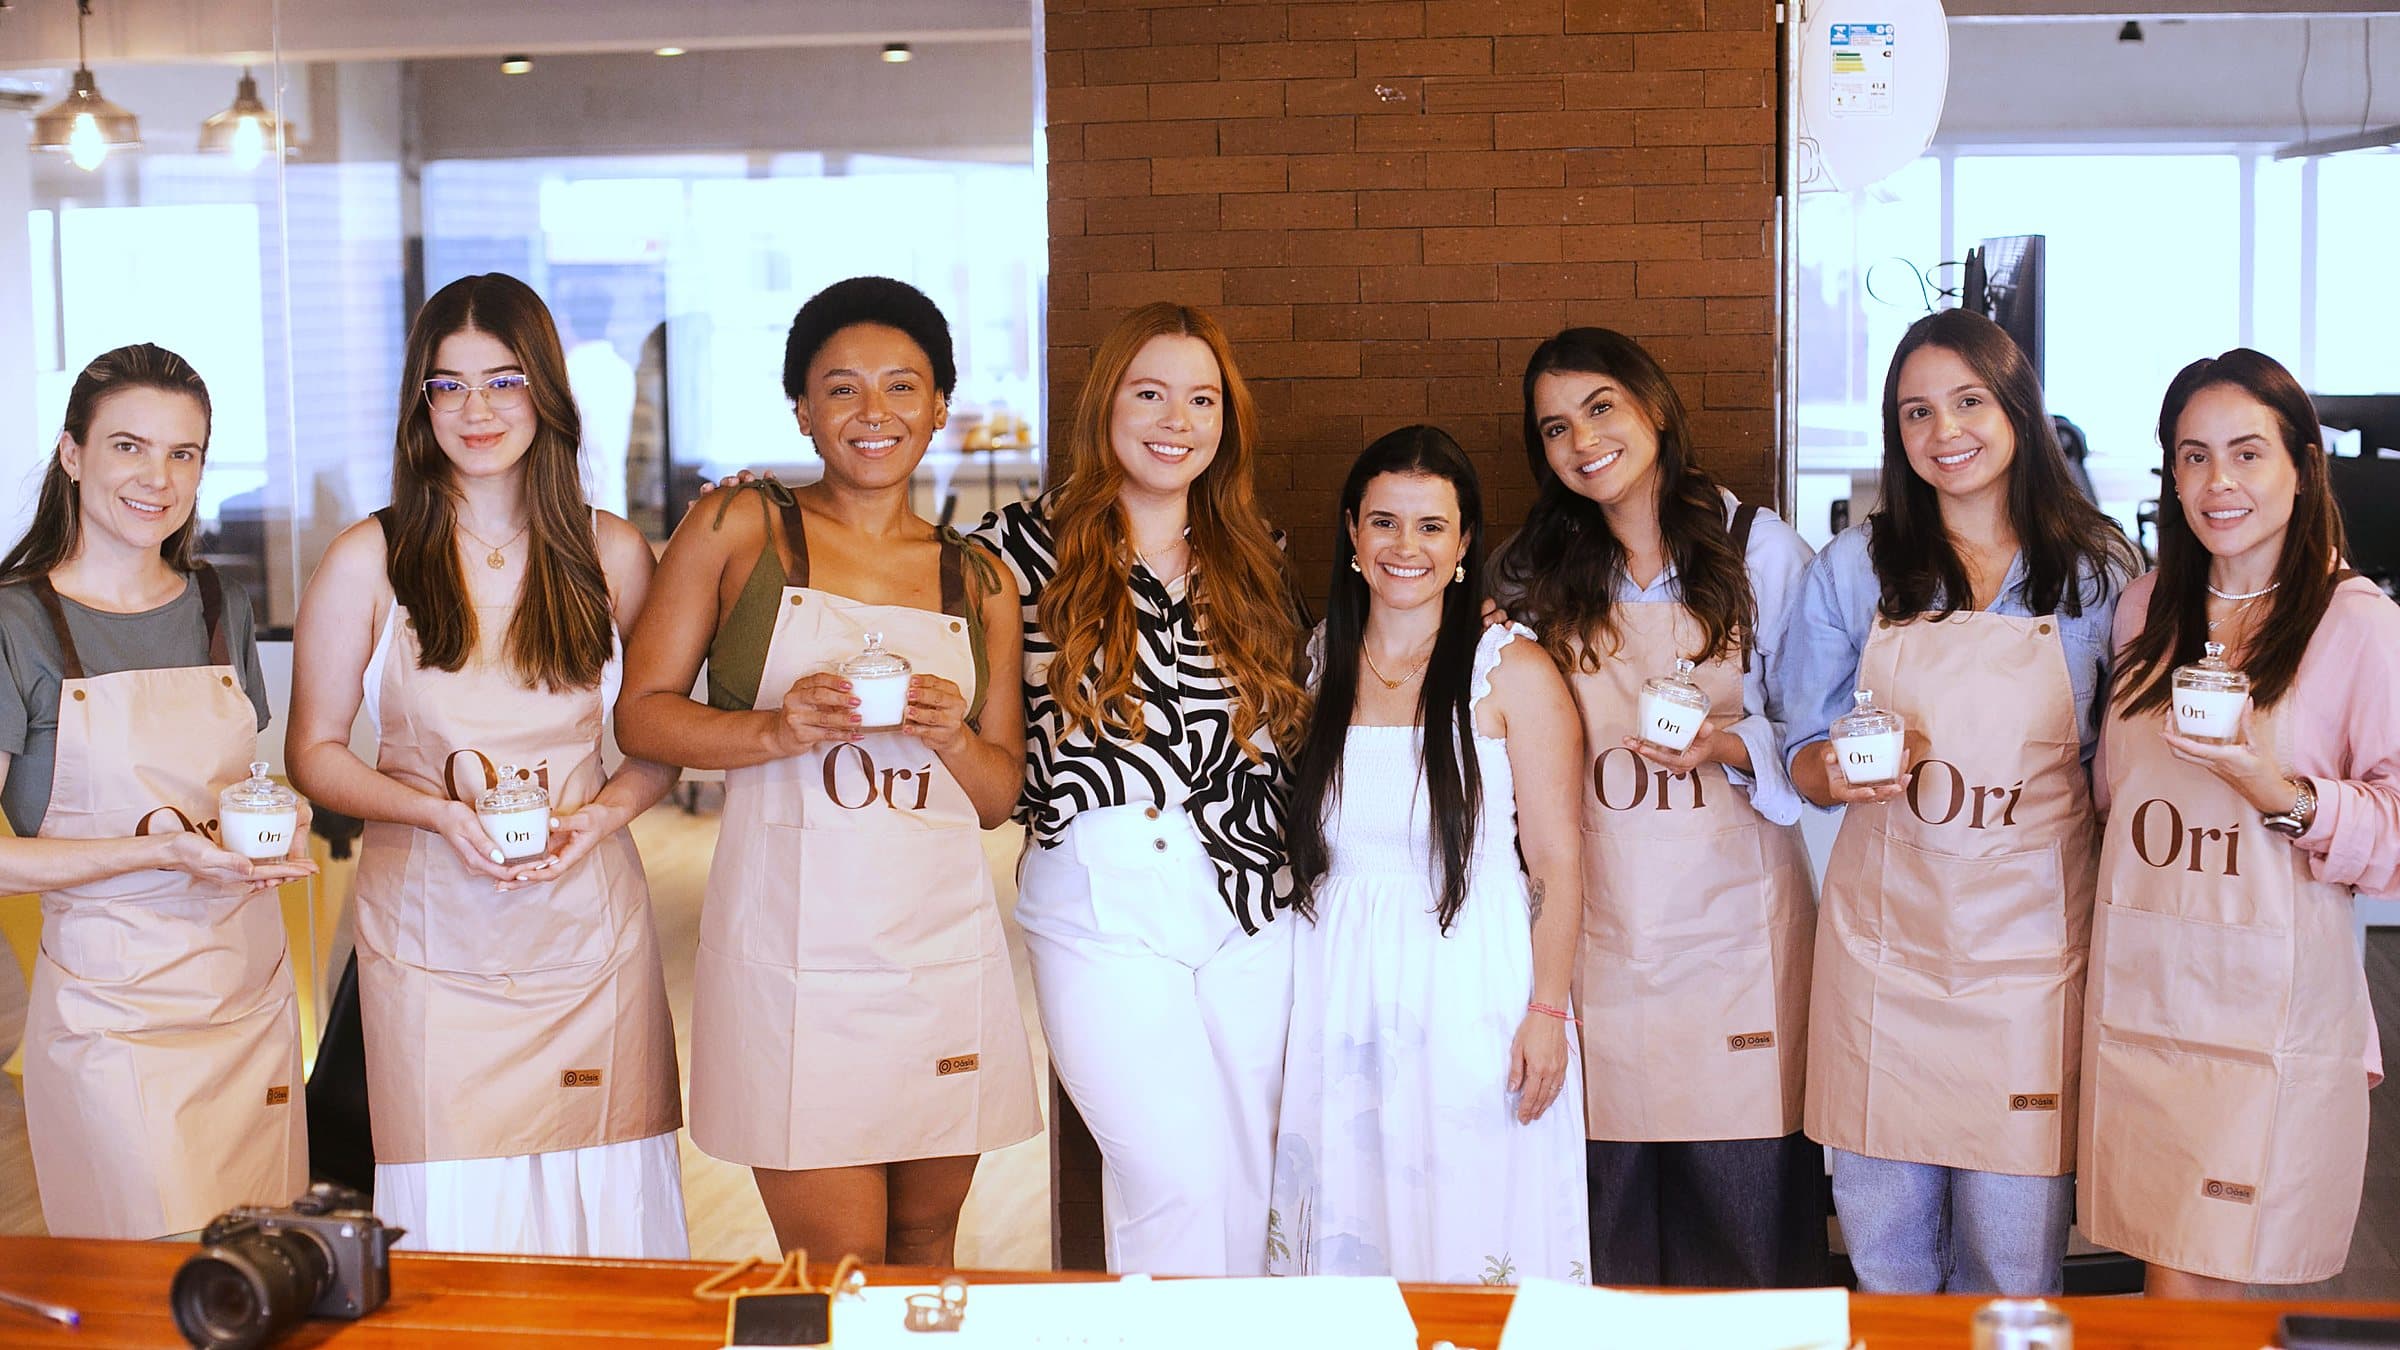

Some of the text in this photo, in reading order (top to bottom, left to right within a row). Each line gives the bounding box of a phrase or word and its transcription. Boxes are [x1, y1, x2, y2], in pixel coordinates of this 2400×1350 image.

[823, 743, 931, 809] Orí
[1906, 760, 2023, 829] Orí
[2132, 799, 2240, 876] Orí
